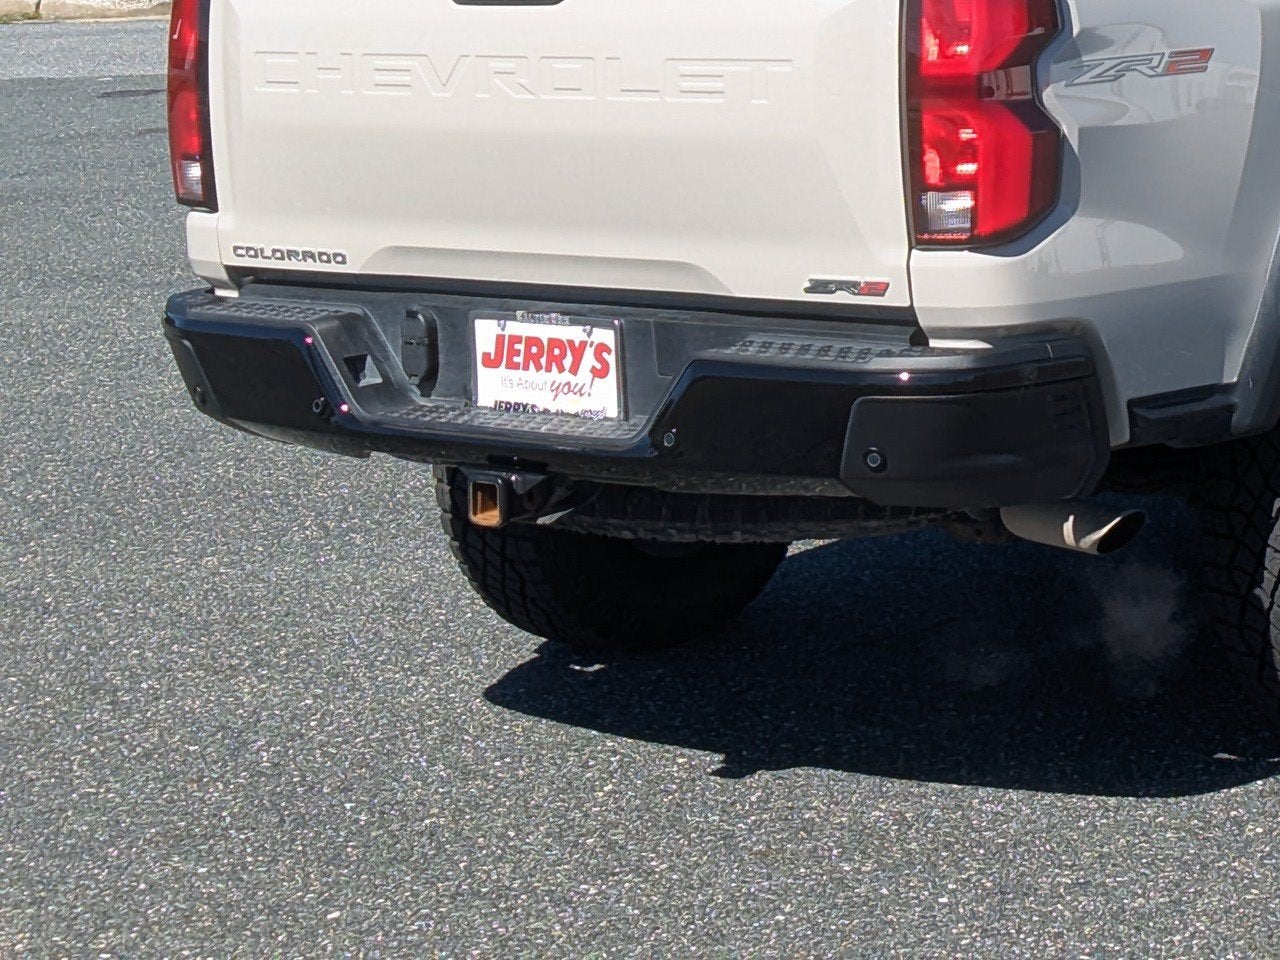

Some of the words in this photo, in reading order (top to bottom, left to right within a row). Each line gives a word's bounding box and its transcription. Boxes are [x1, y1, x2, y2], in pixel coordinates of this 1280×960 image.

[254, 50, 795, 104] CHEVROLET
[1065, 47, 1215, 87] ZR2
[232, 245, 347, 265] COLORADO
[803, 278, 890, 297] ZR2
[481, 333, 613, 380] JERRY'S
[516, 377, 548, 391] About
[549, 374, 596, 402] you!
